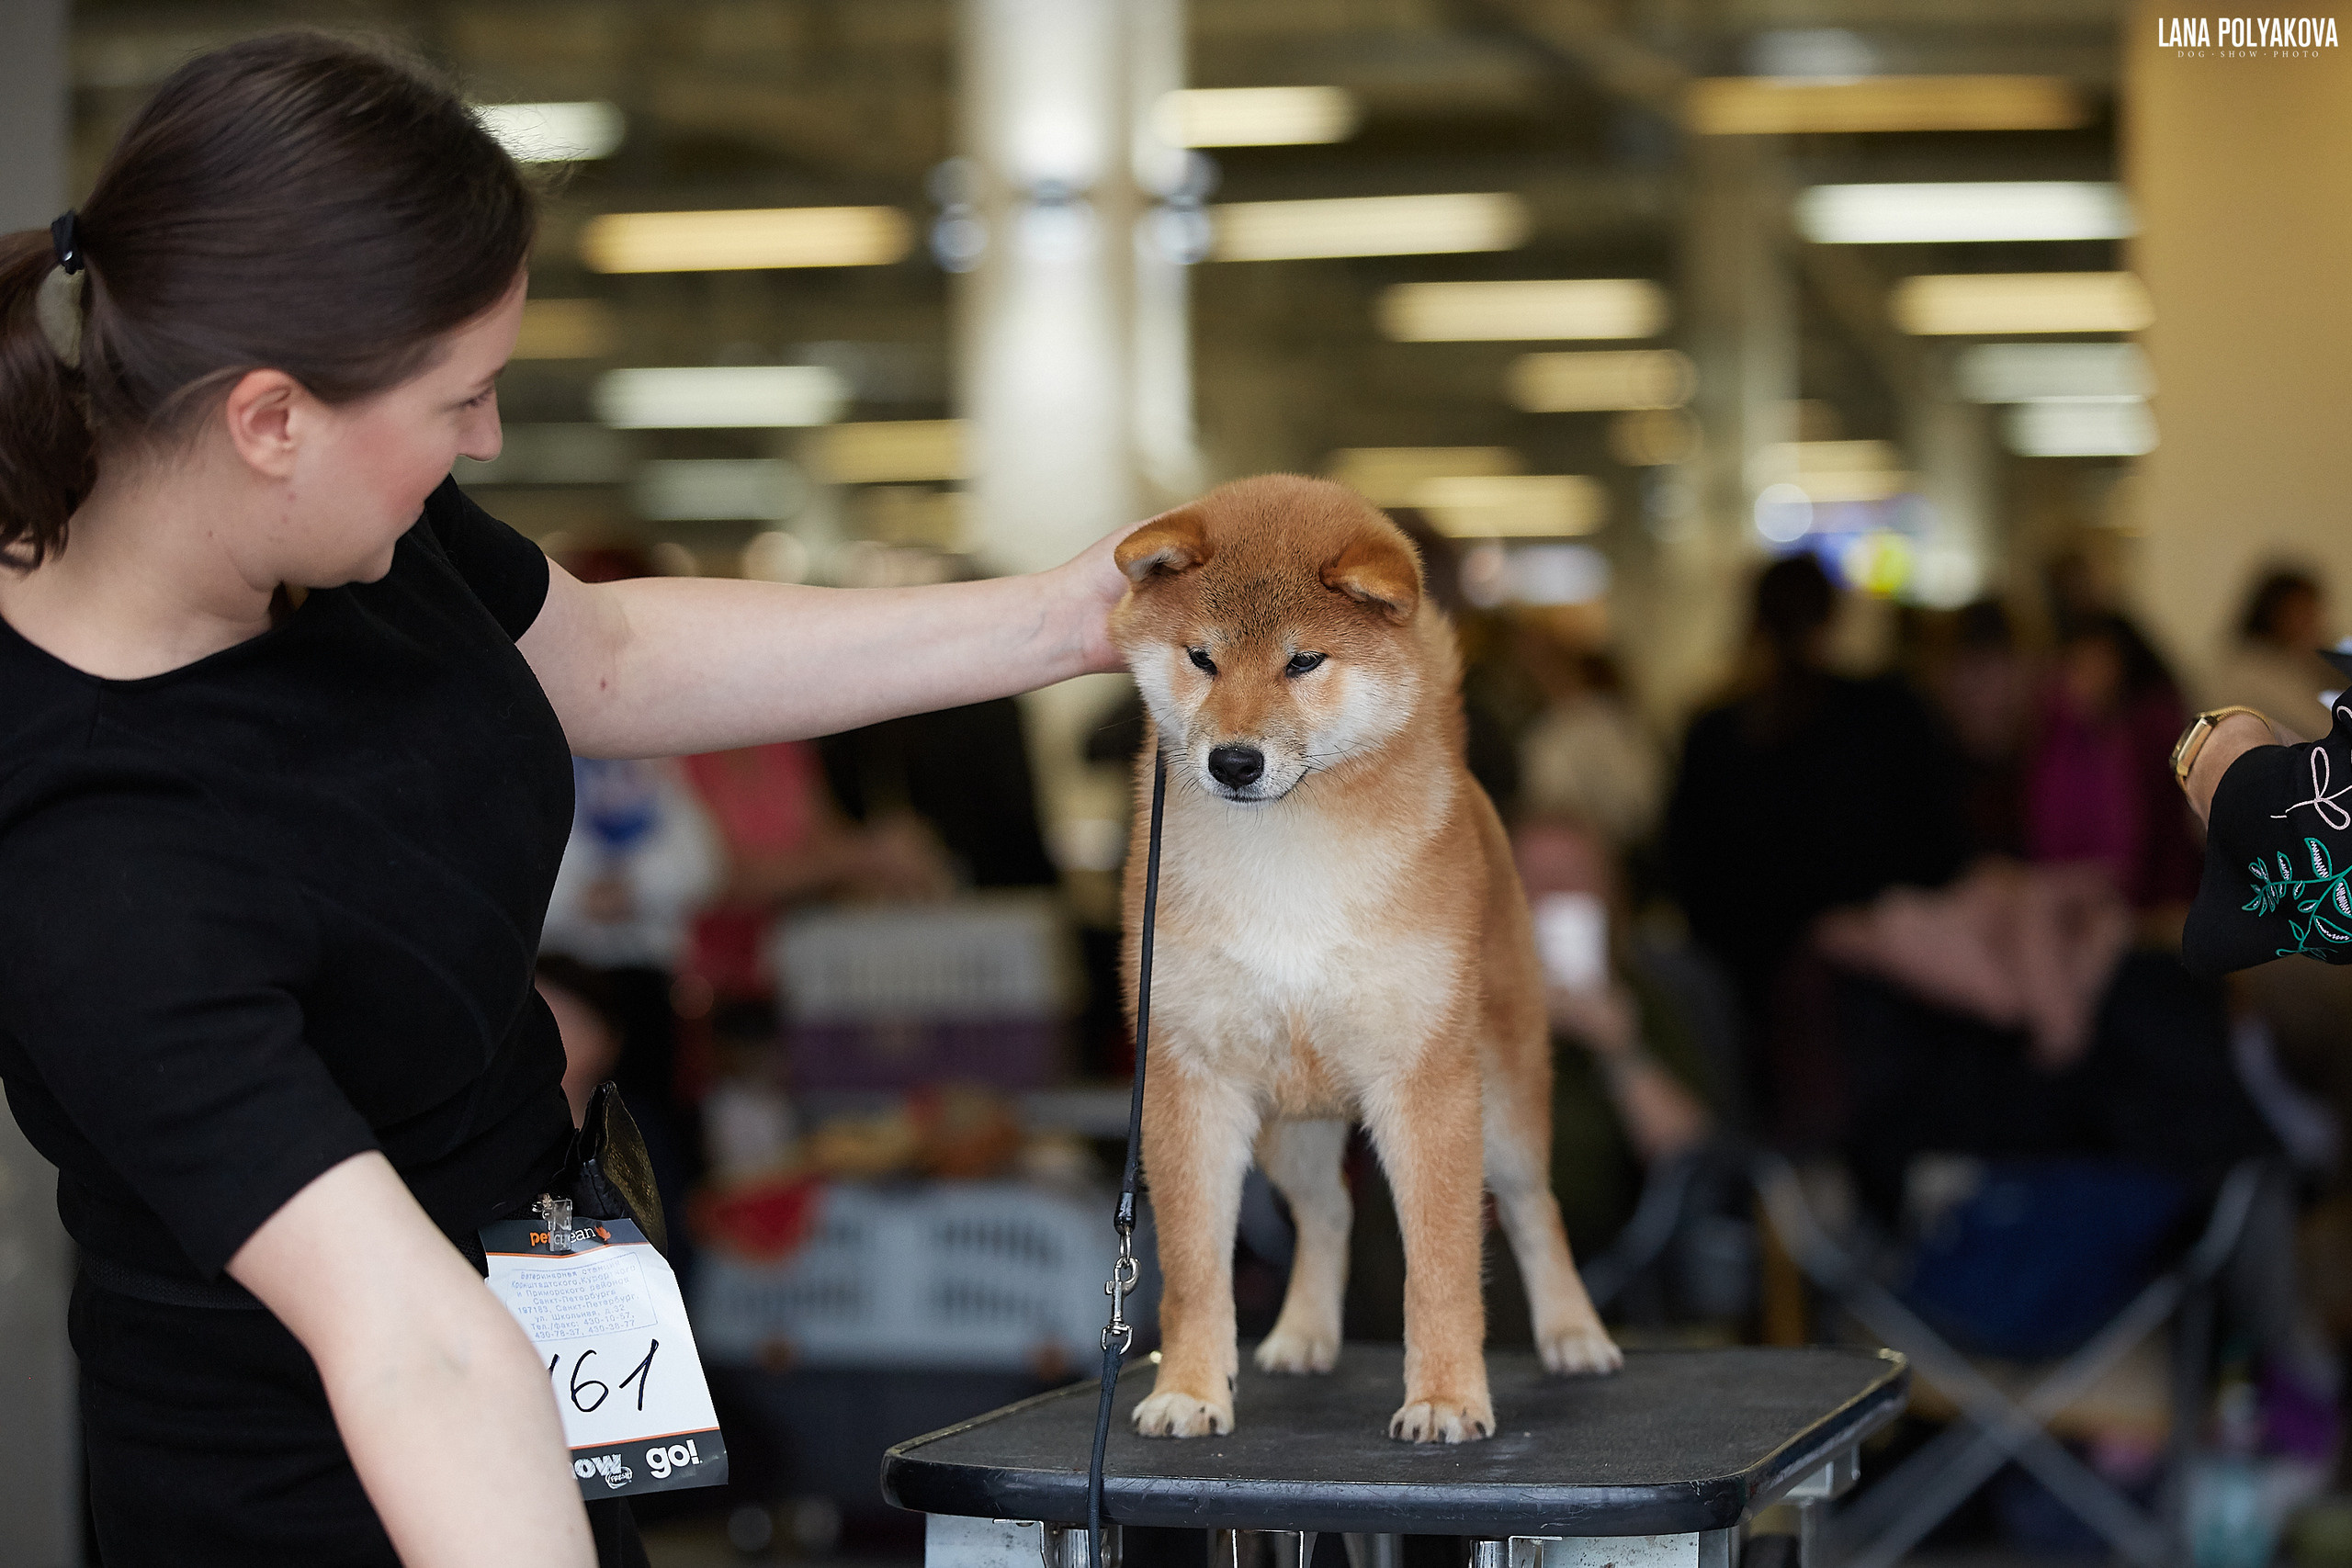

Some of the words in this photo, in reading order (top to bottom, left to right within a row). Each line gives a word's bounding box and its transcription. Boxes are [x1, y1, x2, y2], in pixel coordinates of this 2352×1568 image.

[526, 1286, 585, 1297] Приморского
[533, 1290, 616, 1305] Санкт-Петербурга
[548, 1338, 659, 1412] 61
[569, 1454, 621, 1479] ow
[646, 1438, 699, 1479] go!
